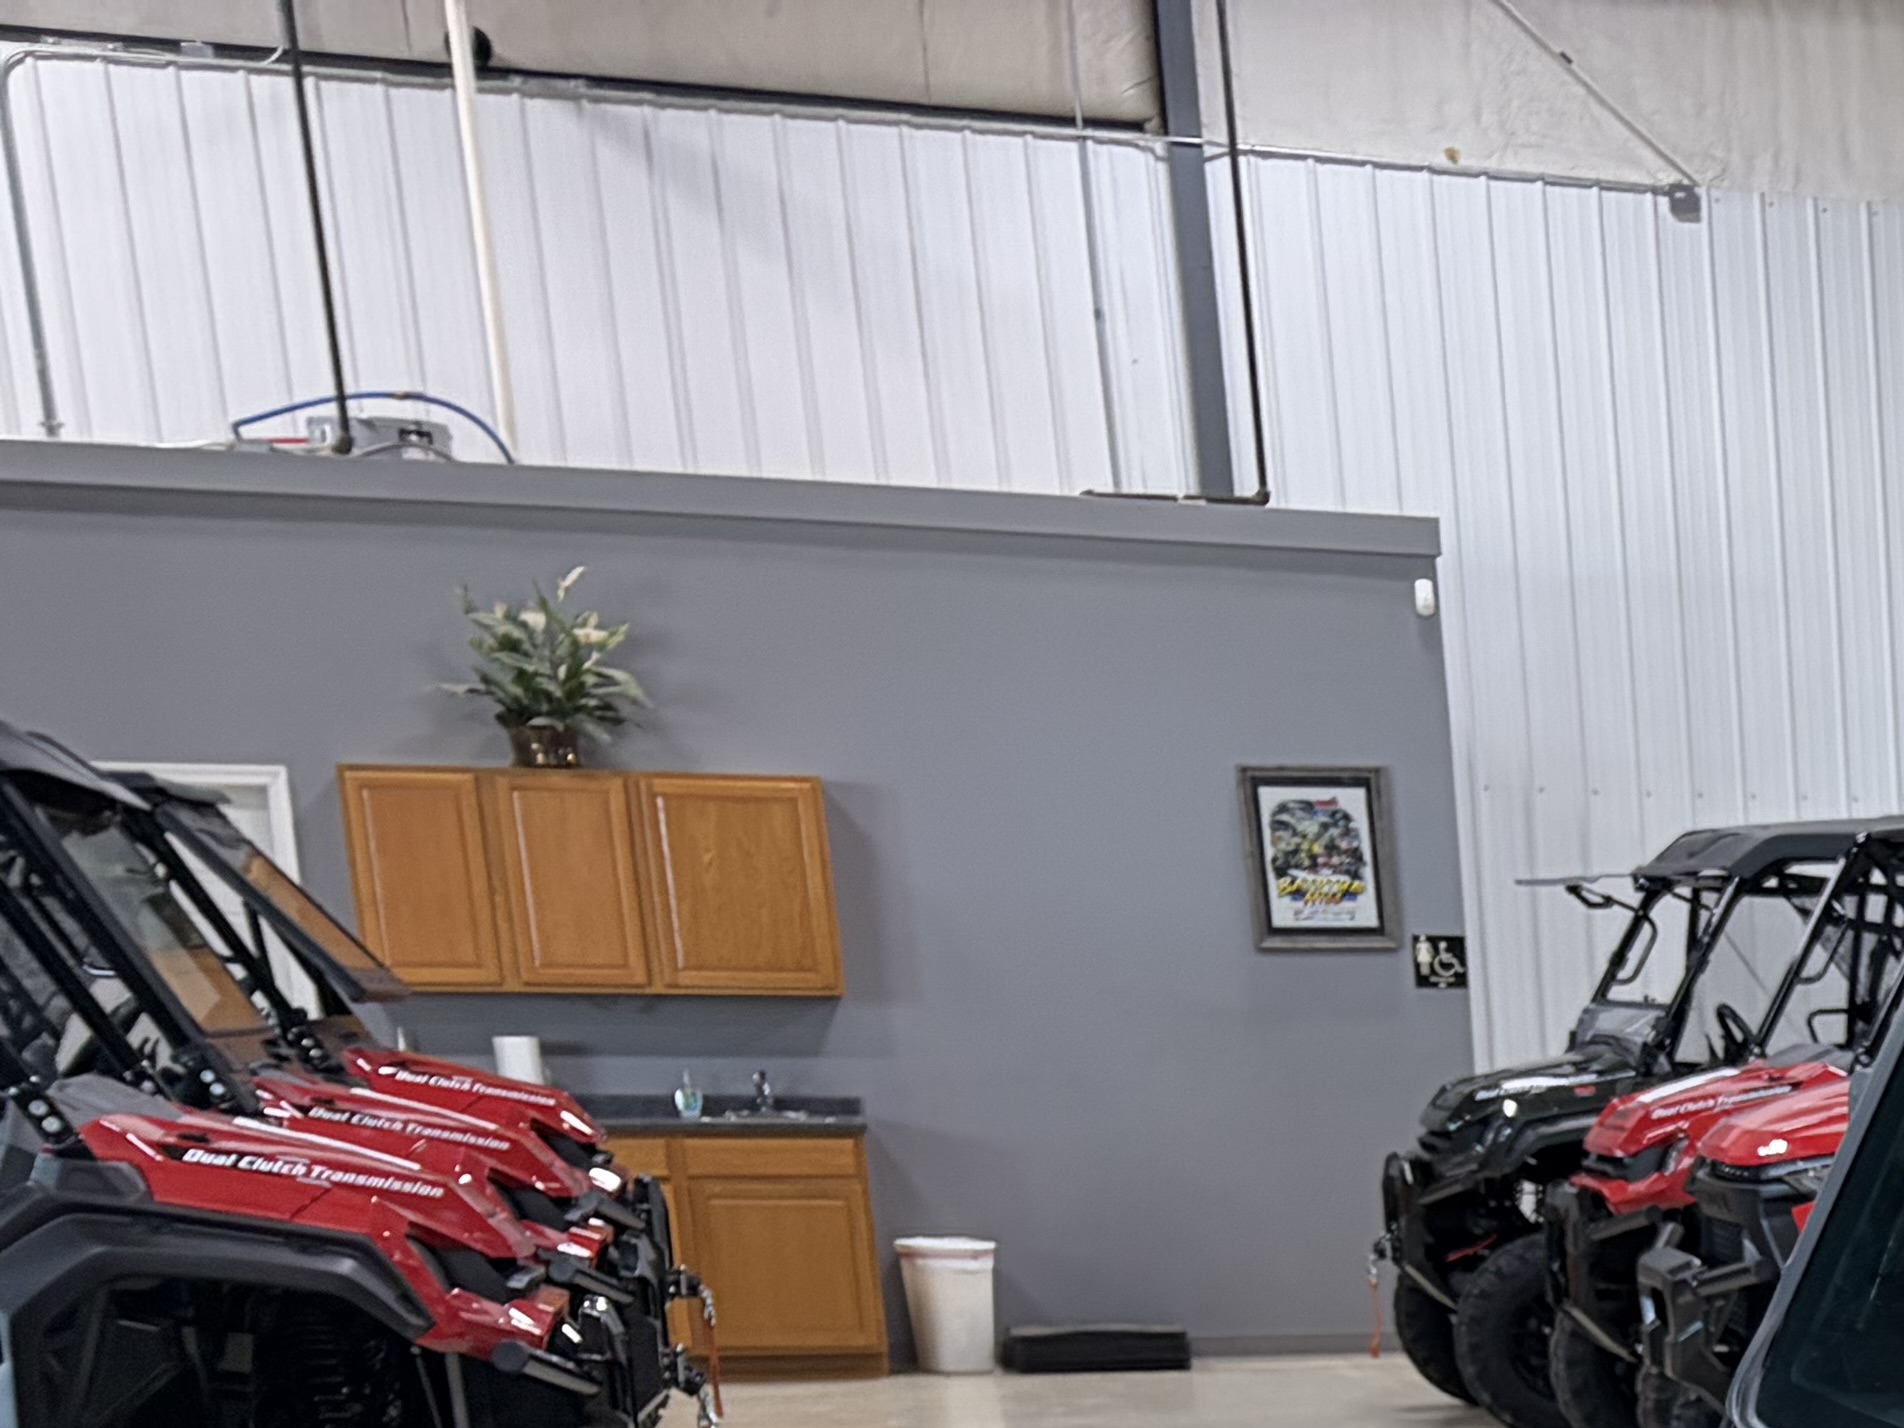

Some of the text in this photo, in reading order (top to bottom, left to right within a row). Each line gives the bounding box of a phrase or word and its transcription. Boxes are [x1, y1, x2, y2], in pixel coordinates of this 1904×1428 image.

[395, 1070, 556, 1106] Dual Clutch Transmission
[309, 1107, 512, 1151] Dual Clutch Transmission
[182, 1148, 445, 1198] Dual Clutch Transmission
